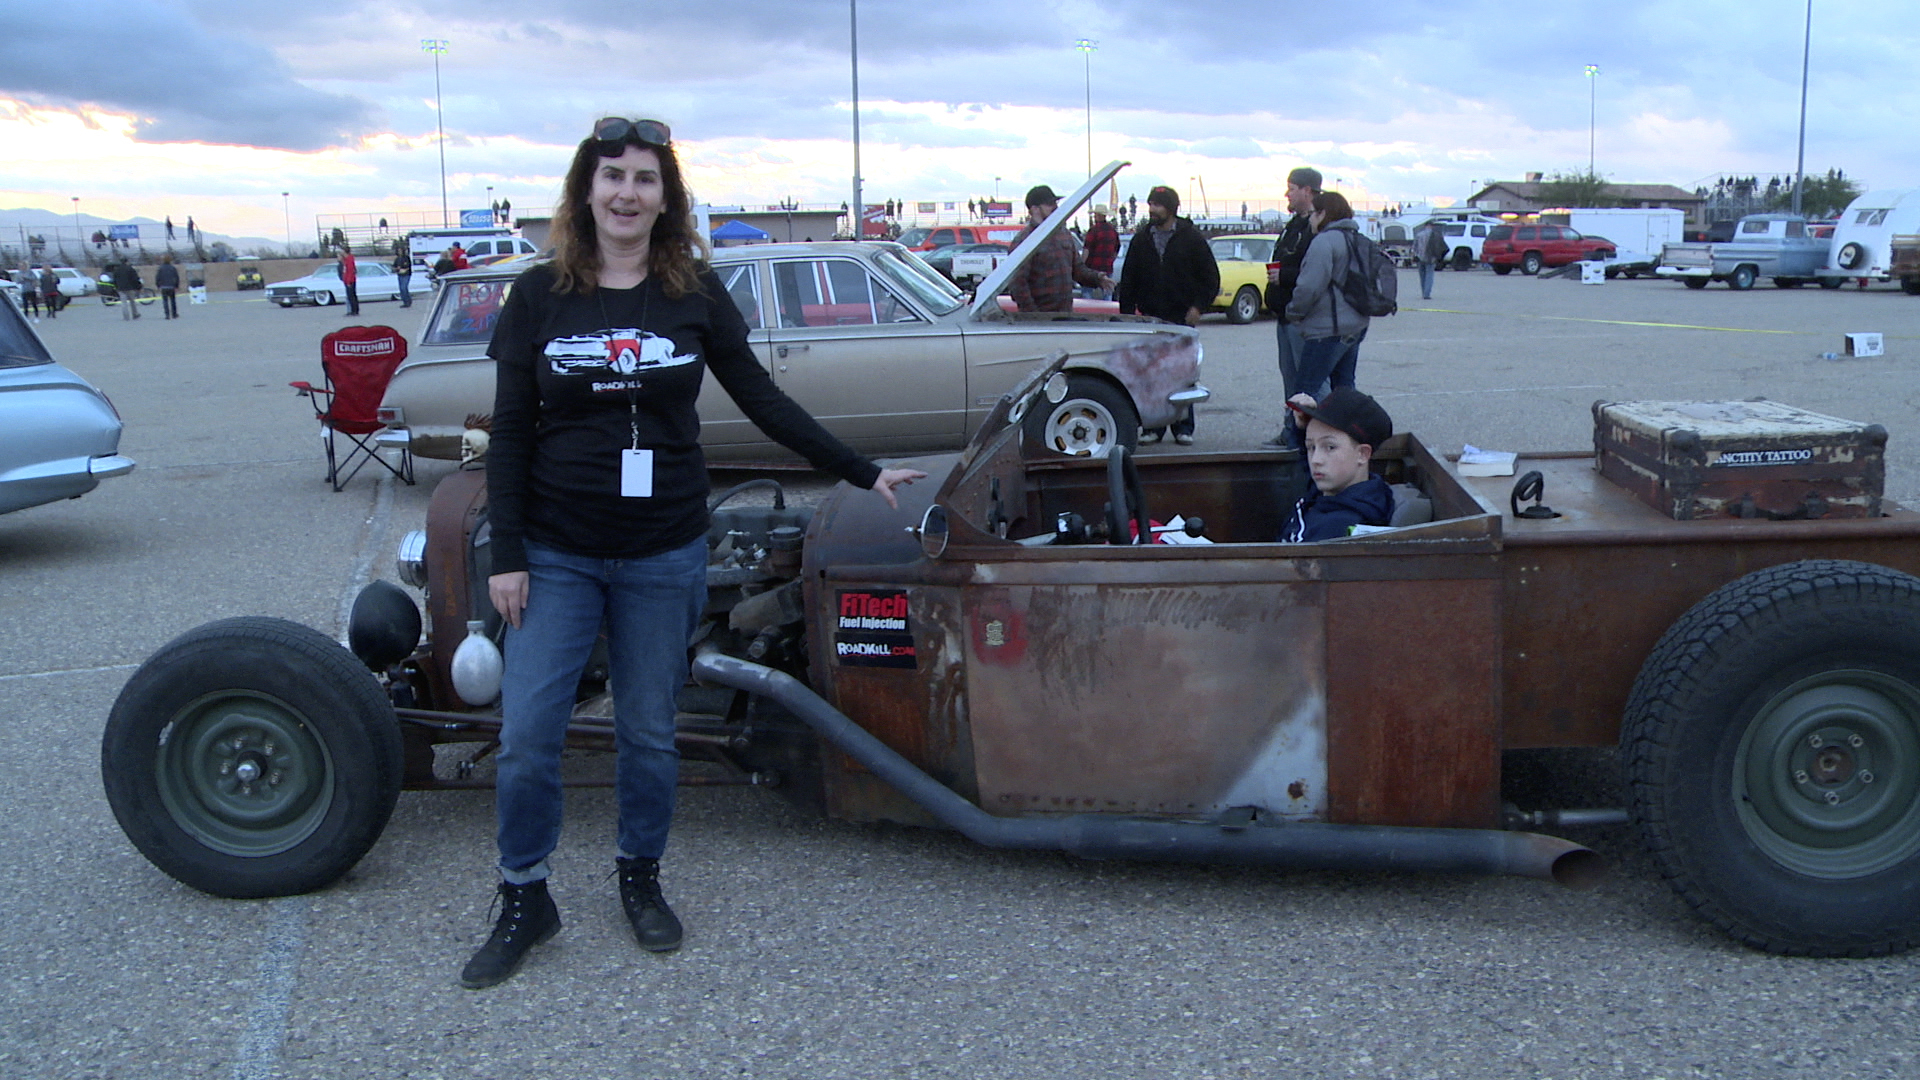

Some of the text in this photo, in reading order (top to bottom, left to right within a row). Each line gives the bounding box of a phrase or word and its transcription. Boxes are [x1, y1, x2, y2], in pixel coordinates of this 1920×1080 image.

[339, 342, 390, 352] CRAFTSMAN
[1765, 449, 1811, 460] TATTOO
[840, 593, 907, 618] FiTech
[839, 617, 905, 629] Fuel Injection
